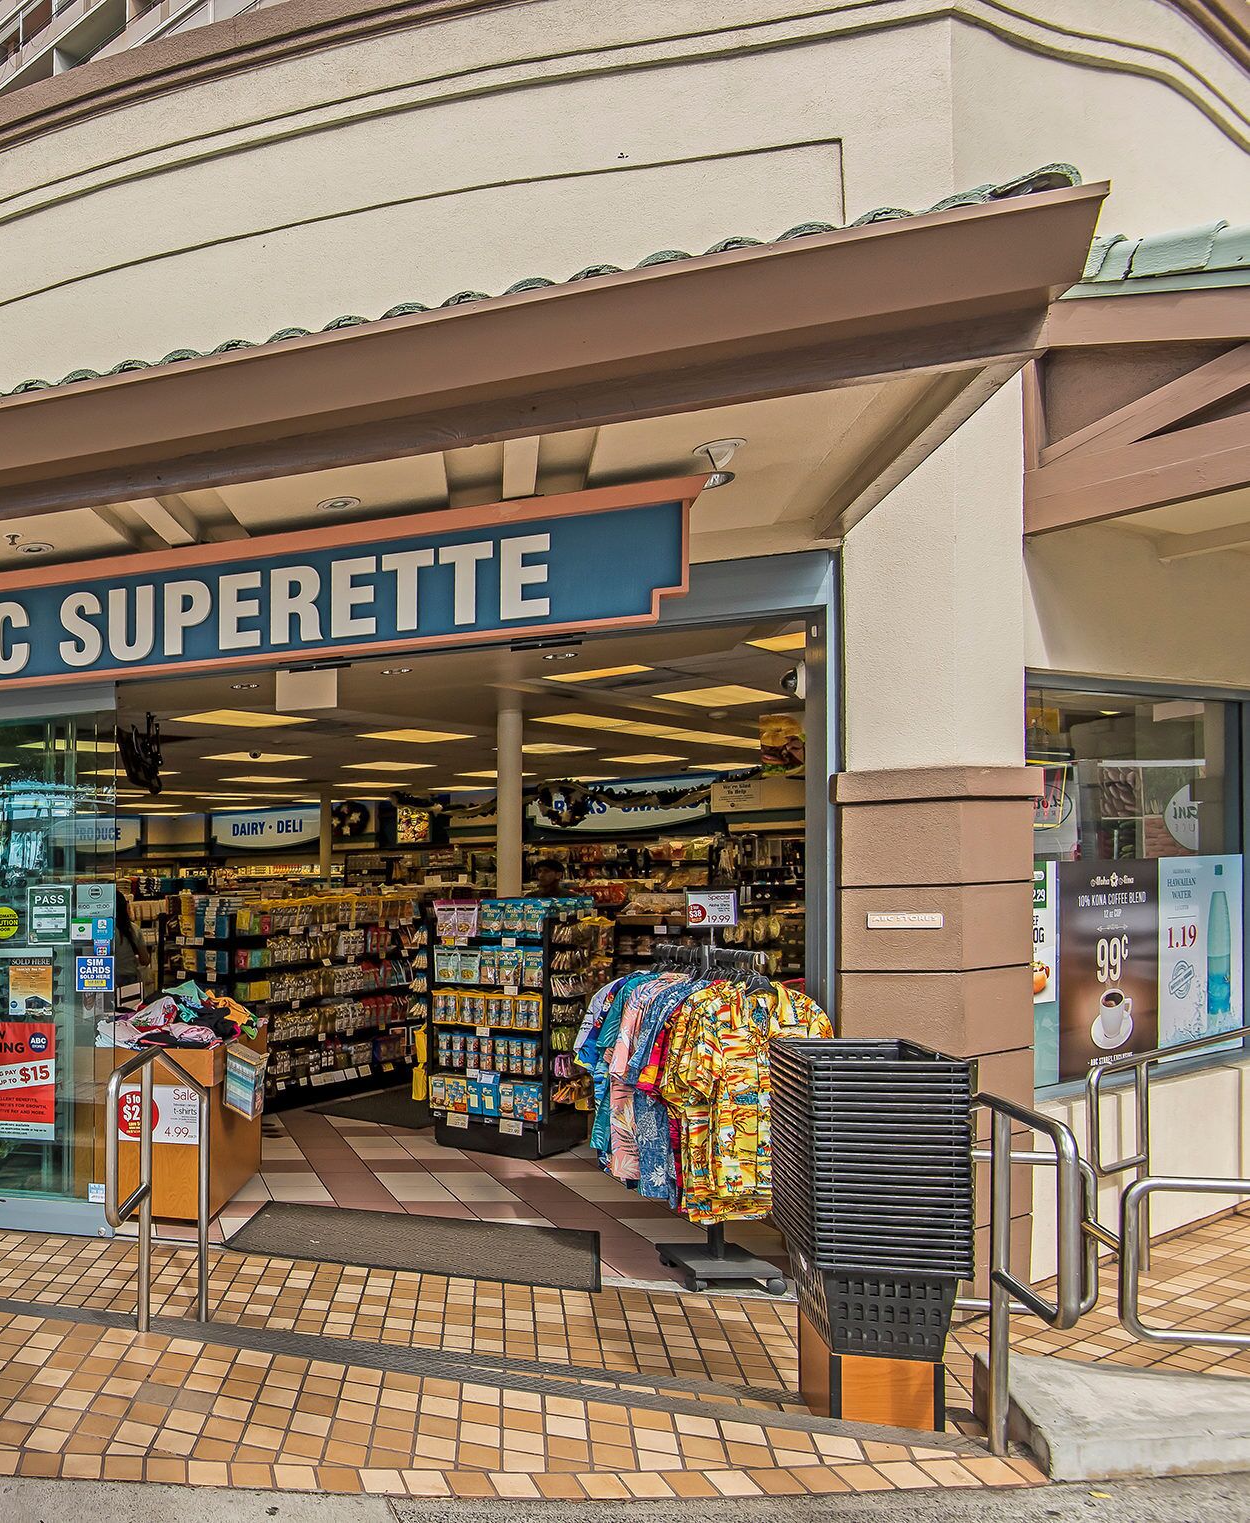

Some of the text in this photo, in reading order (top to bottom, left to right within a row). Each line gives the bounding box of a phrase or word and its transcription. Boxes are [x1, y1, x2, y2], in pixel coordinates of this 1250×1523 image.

[59, 533, 551, 667] SUPERETTE
[232, 818, 303, 836] DAIRY DELI
[34, 895, 65, 904] PASS
[1078, 891, 1147, 907] 10% KONA COFFEE BLEND
[1172, 890, 1191, 899] WATER
[689, 910, 702, 918] $38
[707, 915, 730, 923] 19.99
[1168, 924, 1197, 948] 1.19
[79, 966, 111, 974] CARDS
[19, 1065, 50, 1083] $15
[126, 1094, 132, 1104] 5
[173, 1088, 197, 1101] Sale
[123, 1104, 141, 1122] $2
[173, 1107, 197, 1115] t-shirts
[164, 1126, 190, 1138] 4.99
